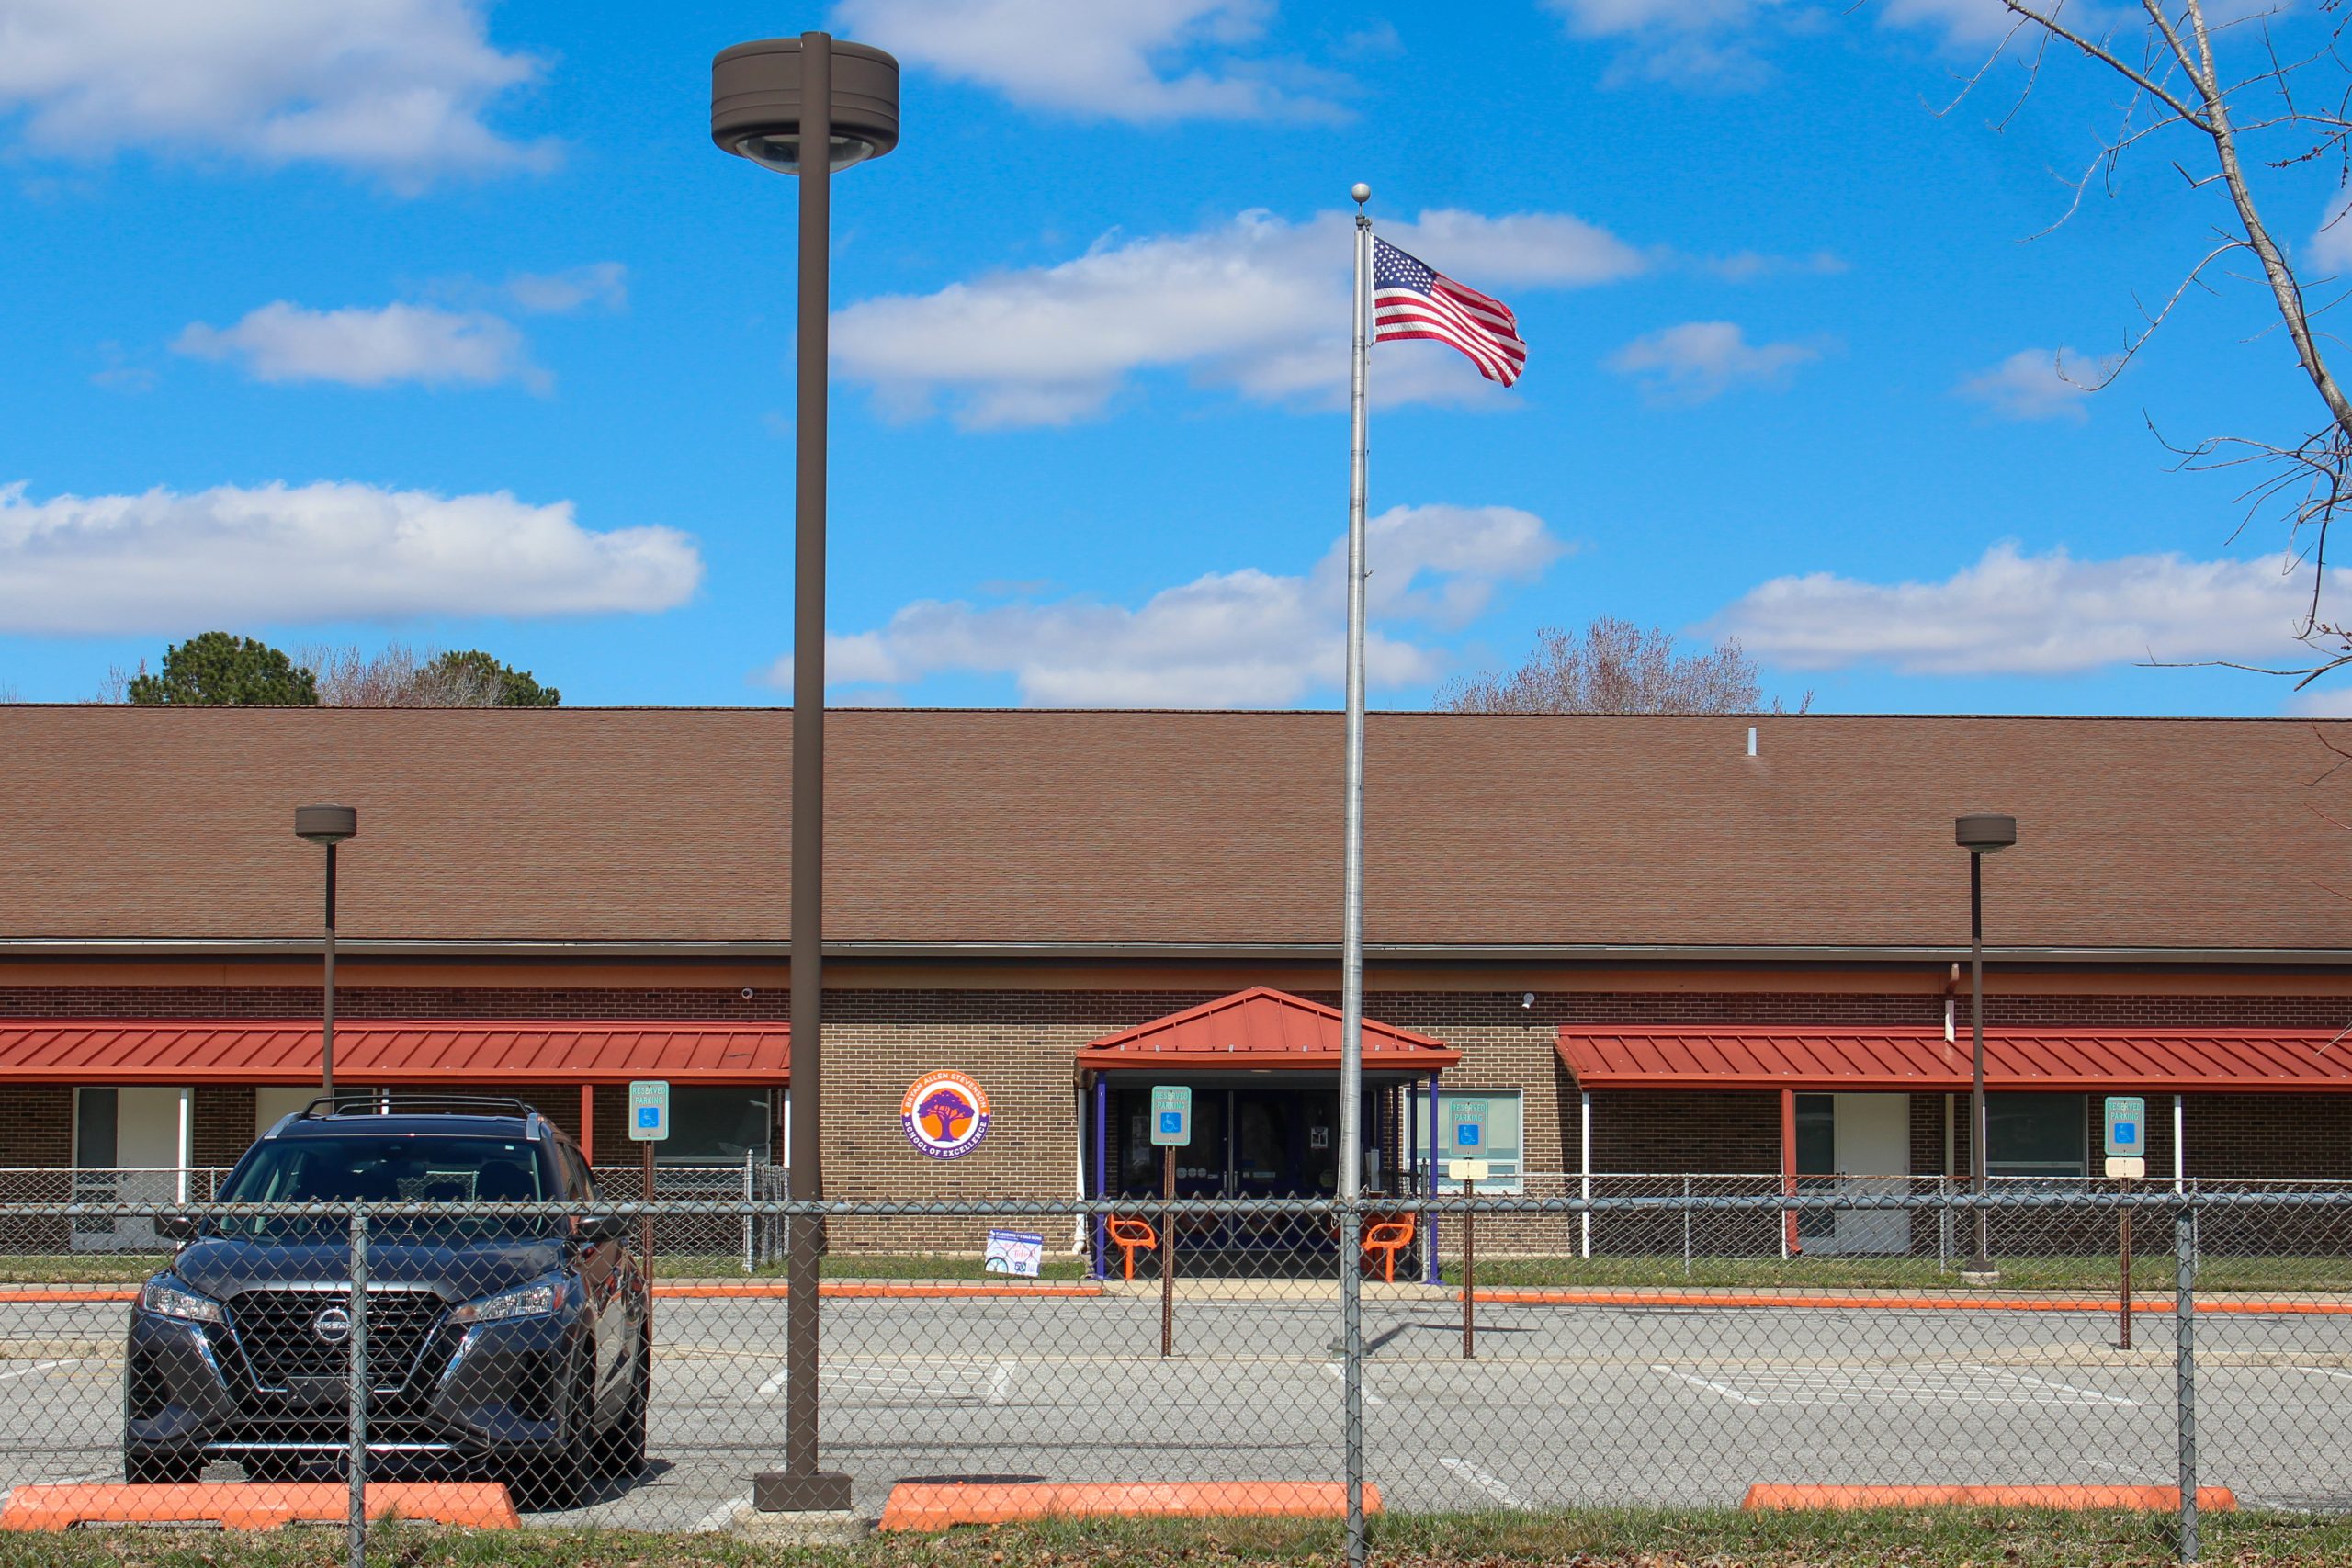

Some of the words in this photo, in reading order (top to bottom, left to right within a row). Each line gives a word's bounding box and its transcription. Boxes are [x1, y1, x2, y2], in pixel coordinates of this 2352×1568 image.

[632, 1087, 666, 1095] RESERVED
[905, 1082, 923, 1108] BRYAN
[923, 1072, 949, 1085] ALLEN
[950, 1073, 987, 1108] STEVENSON
[1155, 1092, 1188, 1100] RESERVED
[2108, 1102, 2142, 1111] RESERVED
[1454, 1113, 1484, 1122] PARKING
[2110, 1112, 2139, 1121] PARKING
[905, 1121, 928, 1151] SCHOOL
[929, 1147, 942, 1156] OF
[943, 1121, 987, 1156] EXCELLENCE
